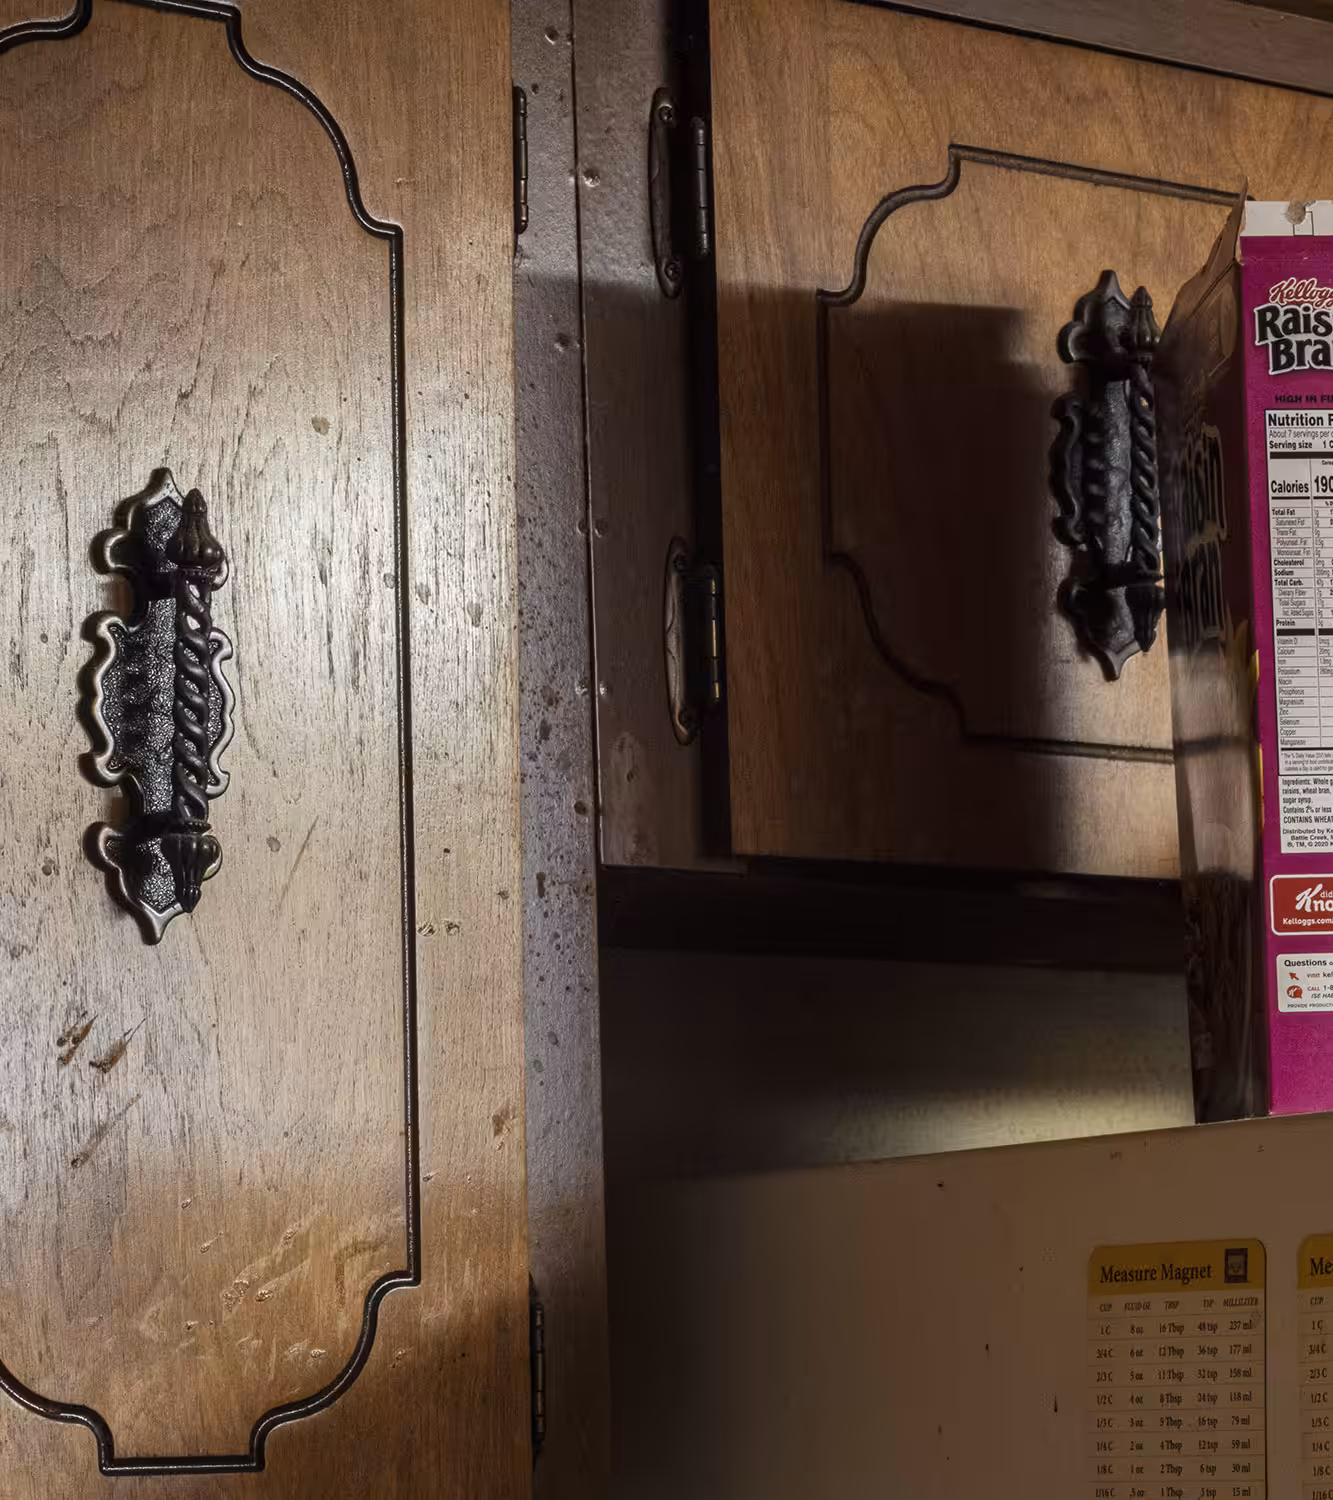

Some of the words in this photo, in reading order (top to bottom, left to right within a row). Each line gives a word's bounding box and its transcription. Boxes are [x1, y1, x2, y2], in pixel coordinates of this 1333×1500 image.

[1275, 395, 1302, 404] HIGH
[1306, 395, 1317, 403] IN
[1268, 413, 1324, 426] Nutrition
[1269, 430, 1287, 438] About
[1293, 430, 1319, 440] servings
[1320, 431, 1330, 439] per
[1269, 440, 1297, 450] Serving
[1298, 441, 1313, 449] size
[1271, 480, 1309, 493] Calories
[1283, 816, 1313, 824] CONTAINS
[1314, 815, 1333, 823] WHEAT
[1284, 959, 1327, 967] Questions
[1100, 1265, 1157, 1284] Measure
[1160, 1264, 1212, 1286] Magnet
